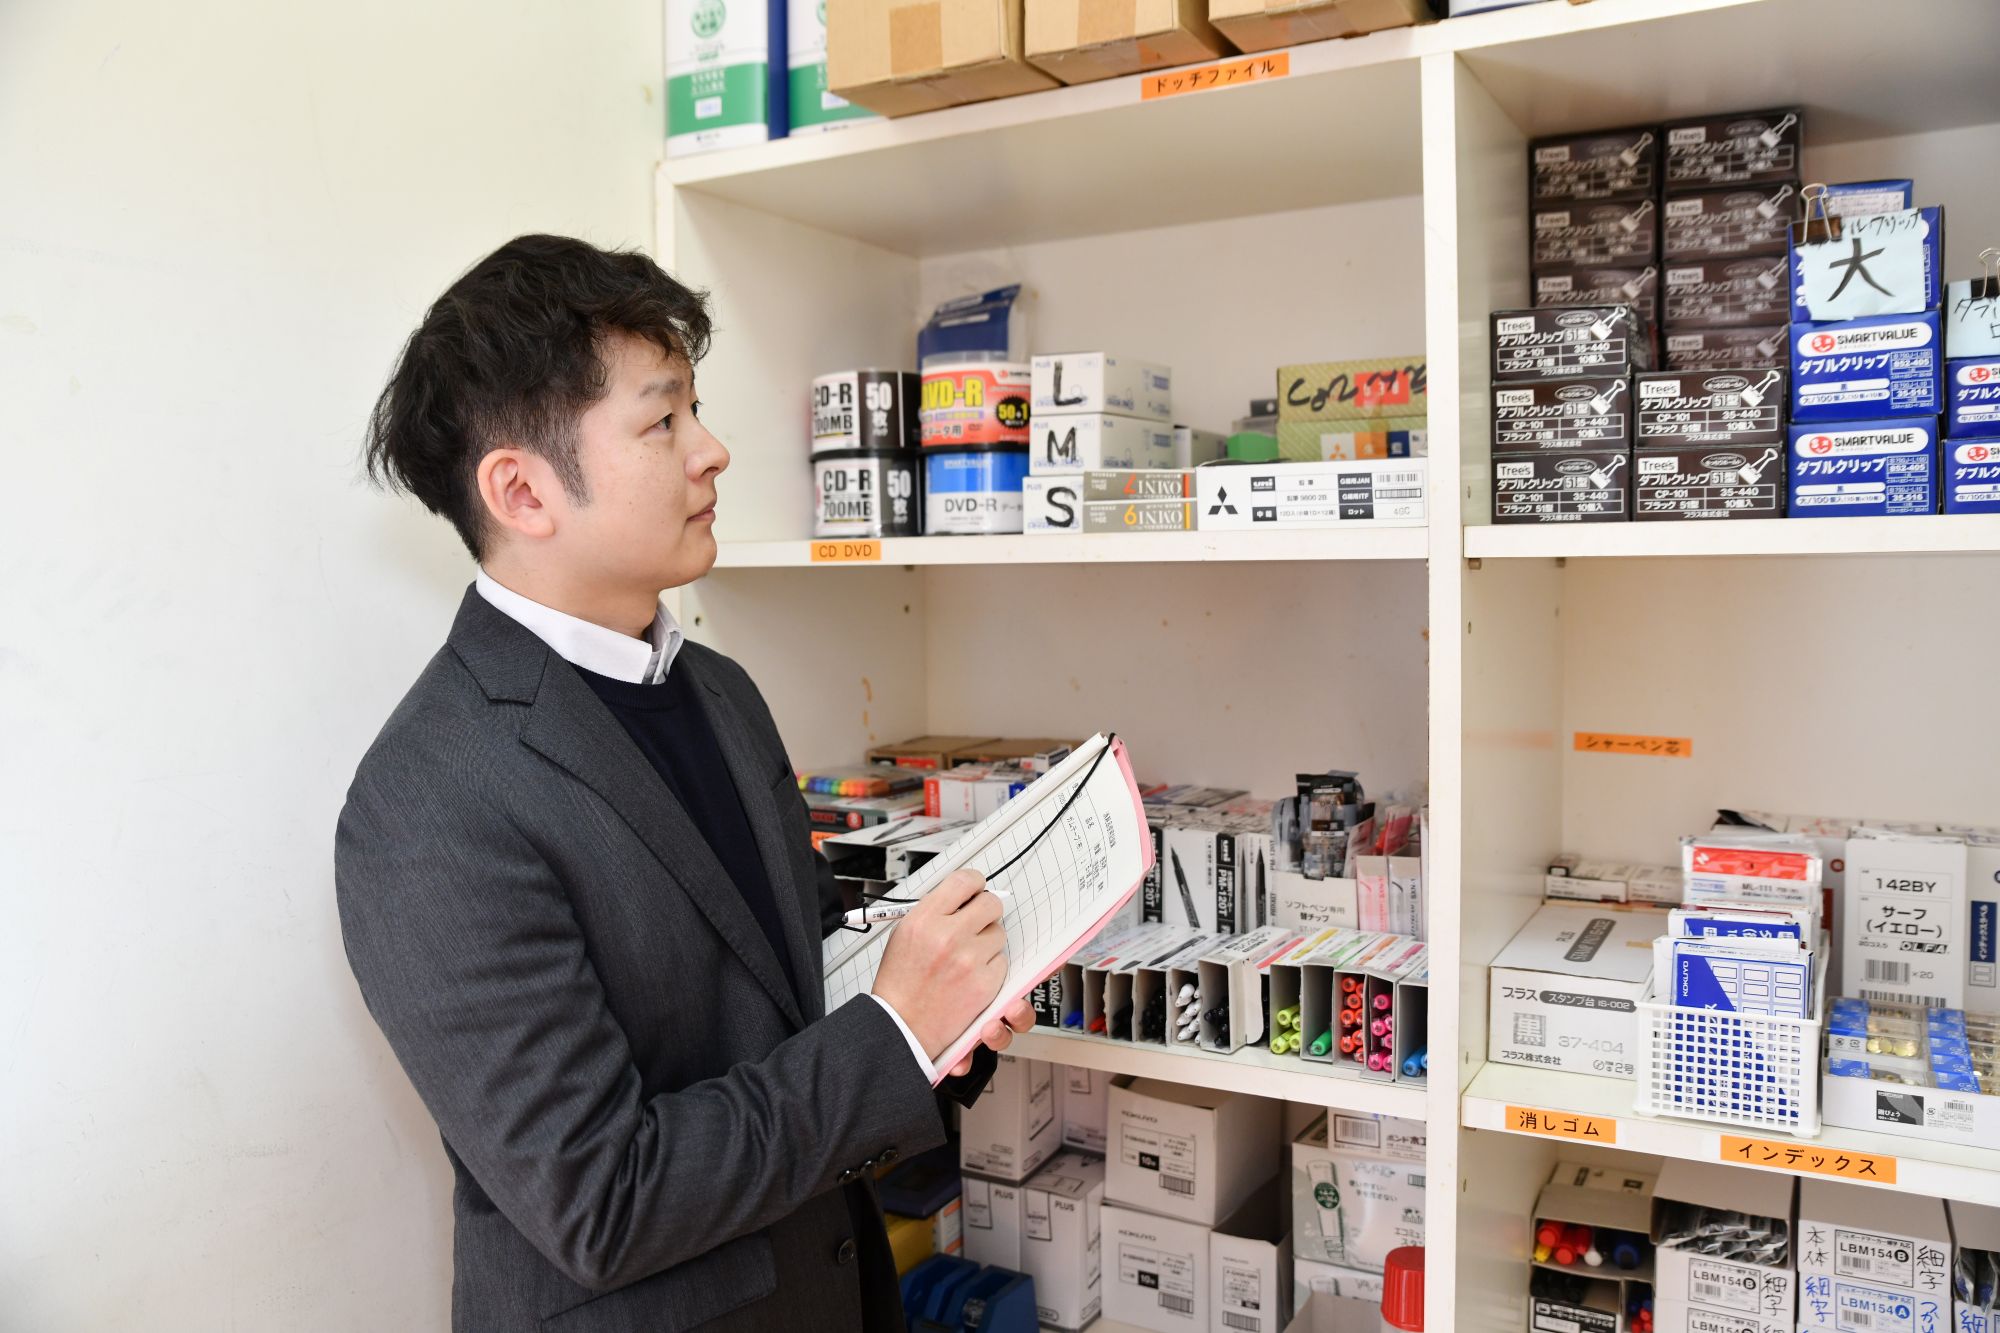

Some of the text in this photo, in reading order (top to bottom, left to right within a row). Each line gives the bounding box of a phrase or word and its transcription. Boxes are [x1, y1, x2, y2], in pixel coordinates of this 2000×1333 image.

[1157, 59, 1275, 93] ドッチファイル
[1827, 238, 1895, 302] 大
[1498, 331, 1564, 346] ダブルクリップ
[1837, 327, 1919, 345] SMARTVALUE
[1798, 353, 1890, 376] ダブルクリップ
[1053, 360, 1087, 406] L
[865, 382, 893, 411] 50
[1640, 396, 1713, 410] ダブルクリップ
[872, 411, 888, 428] 枚
[1497, 404, 1563, 419] ダブルクリップ
[1047, 426, 1077, 463] M
[1834, 433, 1915, 447] SMARTVALUE
[1795, 457, 1887, 476] ダブルクリップ
[823, 470, 872, 492] CD-R
[887, 470, 911, 498] 50
[1497, 476, 1563, 491] ダブルクリップ
[1638, 471, 1710, 487] ダブルクリップ
[823, 501, 873, 518] 700MB
[893, 498, 908, 516] 枚
[944, 498, 997, 513] DVD-R
[1045, 486, 1077, 528] S
[1347, 508, 1365, 516] ロット
[819, 544, 873, 558] CD DVD
[1586, 736, 1681, 754] シャーペン芯
[1218, 869, 1228, 917] PM-120T
[1876, 878, 1937, 893] 142BY
[1300, 913, 1330, 922] 替チップ
[1882, 906, 1927, 920] サーフ
[1866, 919, 1943, 938] (イエロー)
[1901, 941, 1947, 954] OLFA
[1036, 984, 1046, 1013] PM-
[1502, 986, 1630, 1010] プラス スタンプ台 IS-002
[1518, 1016, 1543, 1044] 黒
[1558, 1035, 1625, 1055] 37-404
[1501, 1050, 1562, 1066] プラス株式会社
[1614, 1062, 1634, 1075] 2号
[1519, 1111, 1600, 1136] 消しゴム
[1737, 1143, 1878, 1176] インデックス
[995, 1190, 1014, 1200] PLUS
[1055, 1200, 1075, 1212] PLUS
[1395, 1227, 1426, 1239] エコミュ
[1804, 1226, 1830, 1267] 本体
[1916, 1245, 1945, 1290] 細字
[1761, 1272, 1788, 1316] 細字
[1805, 1276, 1835, 1323] 細字
